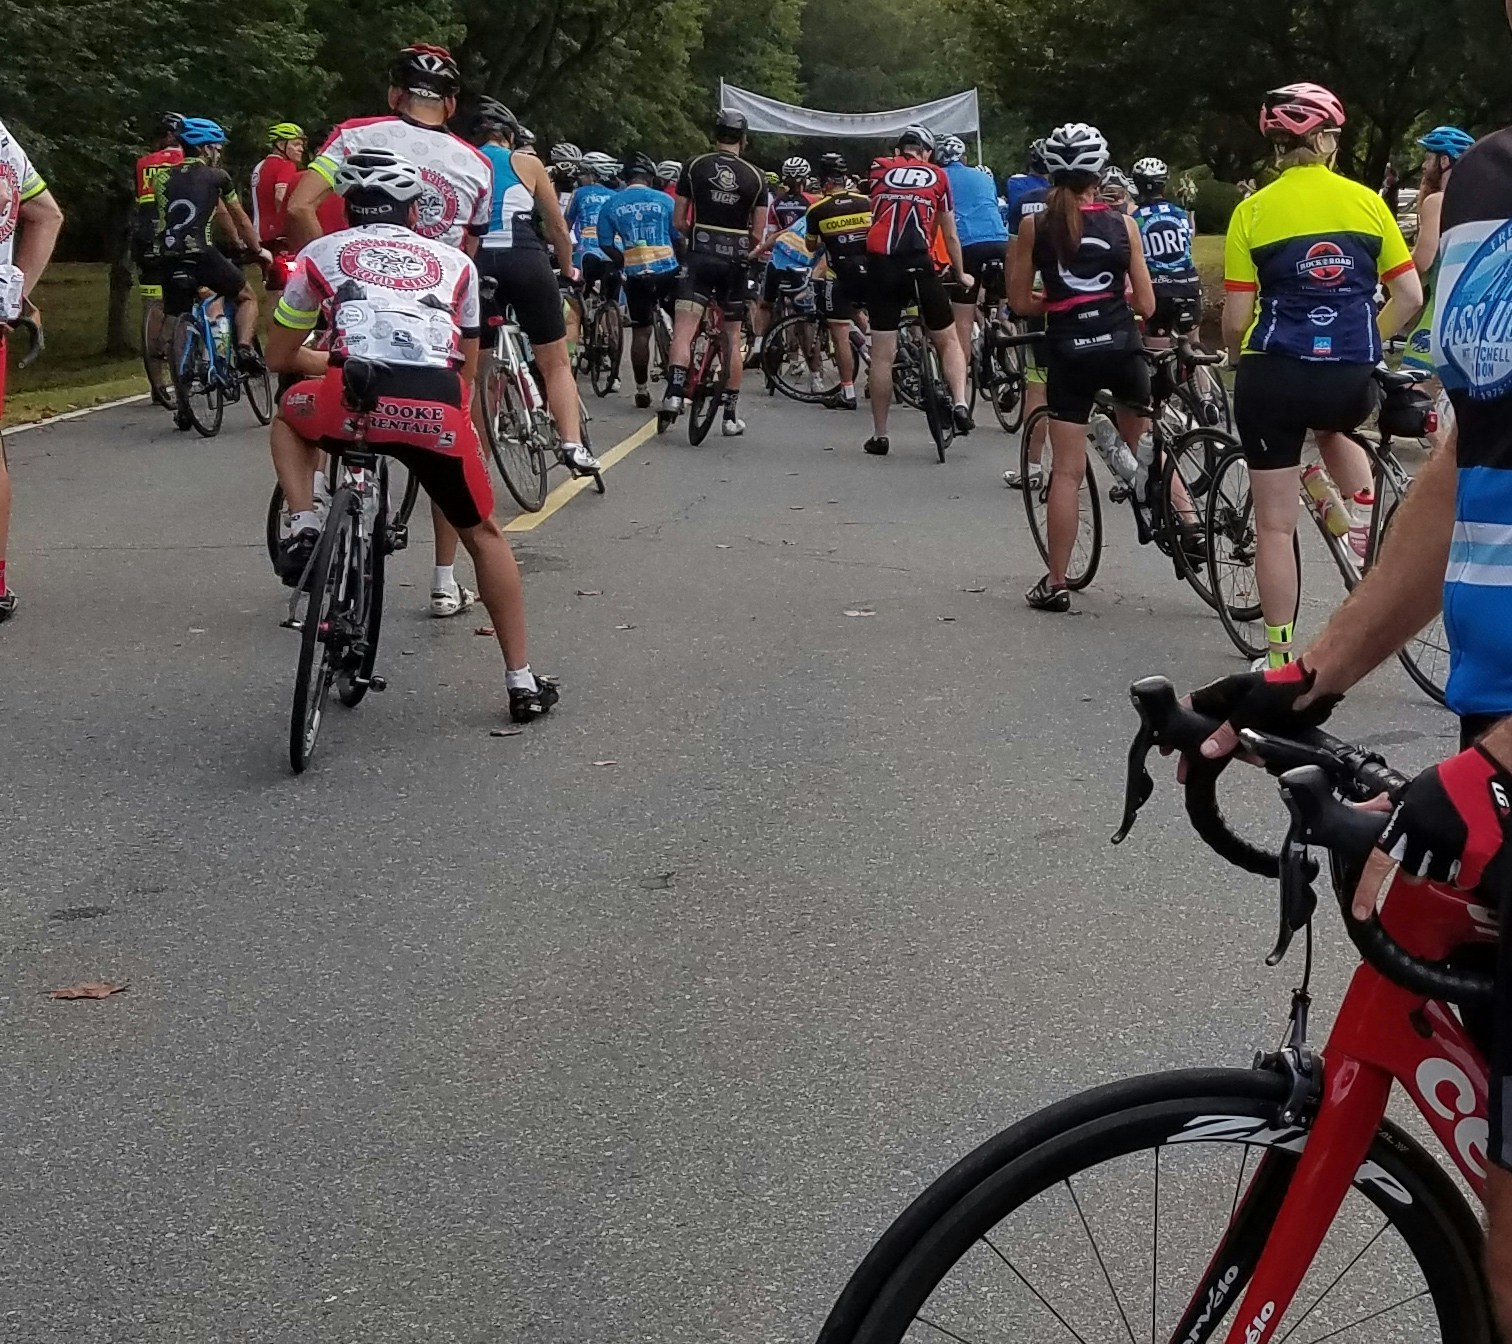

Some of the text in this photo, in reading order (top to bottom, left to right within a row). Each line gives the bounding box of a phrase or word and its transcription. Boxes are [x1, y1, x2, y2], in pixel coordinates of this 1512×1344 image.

[893, 168, 930, 187] IR
[710, 190, 740, 205] UCF
[351, 204, 393, 215] GIRO
[615, 201, 662, 217] niagara
[826, 216, 865, 230] COLOMBIA
[1143, 227, 1187, 257] JDRF
[401, 274, 436, 288] CLUB
[375, 401, 443, 421] COOKE
[369, 416, 442, 435] RENTALS
